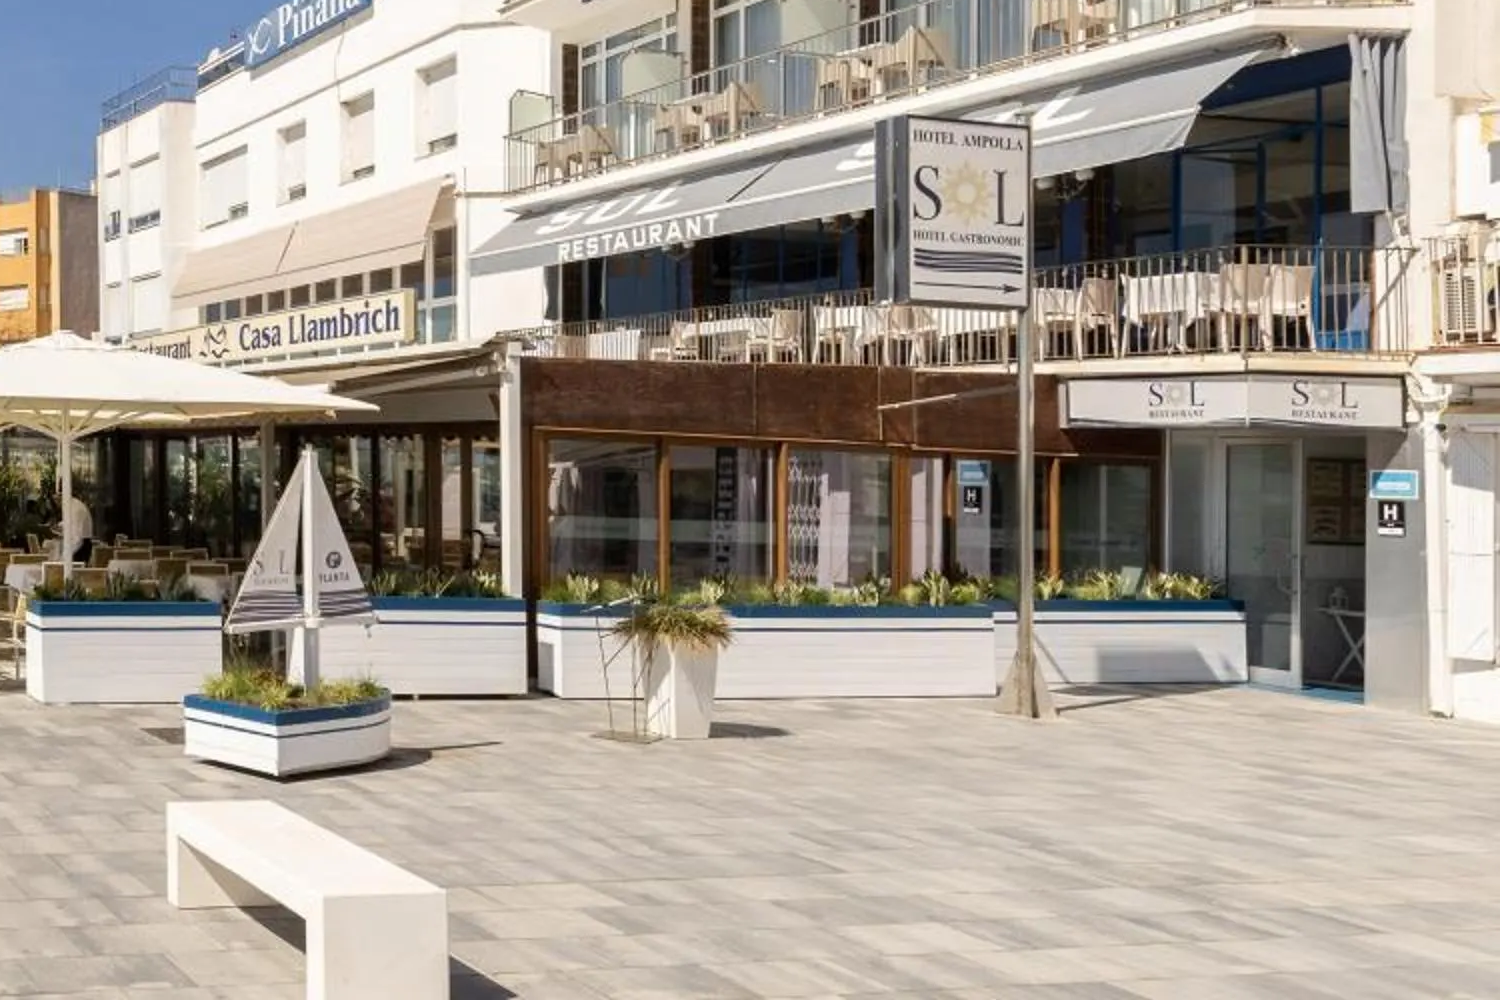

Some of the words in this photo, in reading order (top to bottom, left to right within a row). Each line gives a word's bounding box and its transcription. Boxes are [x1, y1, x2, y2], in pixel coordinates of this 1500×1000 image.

[913, 128, 957, 145] HOTEL
[961, 135, 1024, 151] AMPOLLA
[557, 212, 719, 262] RESTAURANT
[238, 323, 281, 351] Casa
[288, 299, 400, 345] Llambrich
[1383, 504, 1398, 520] H
